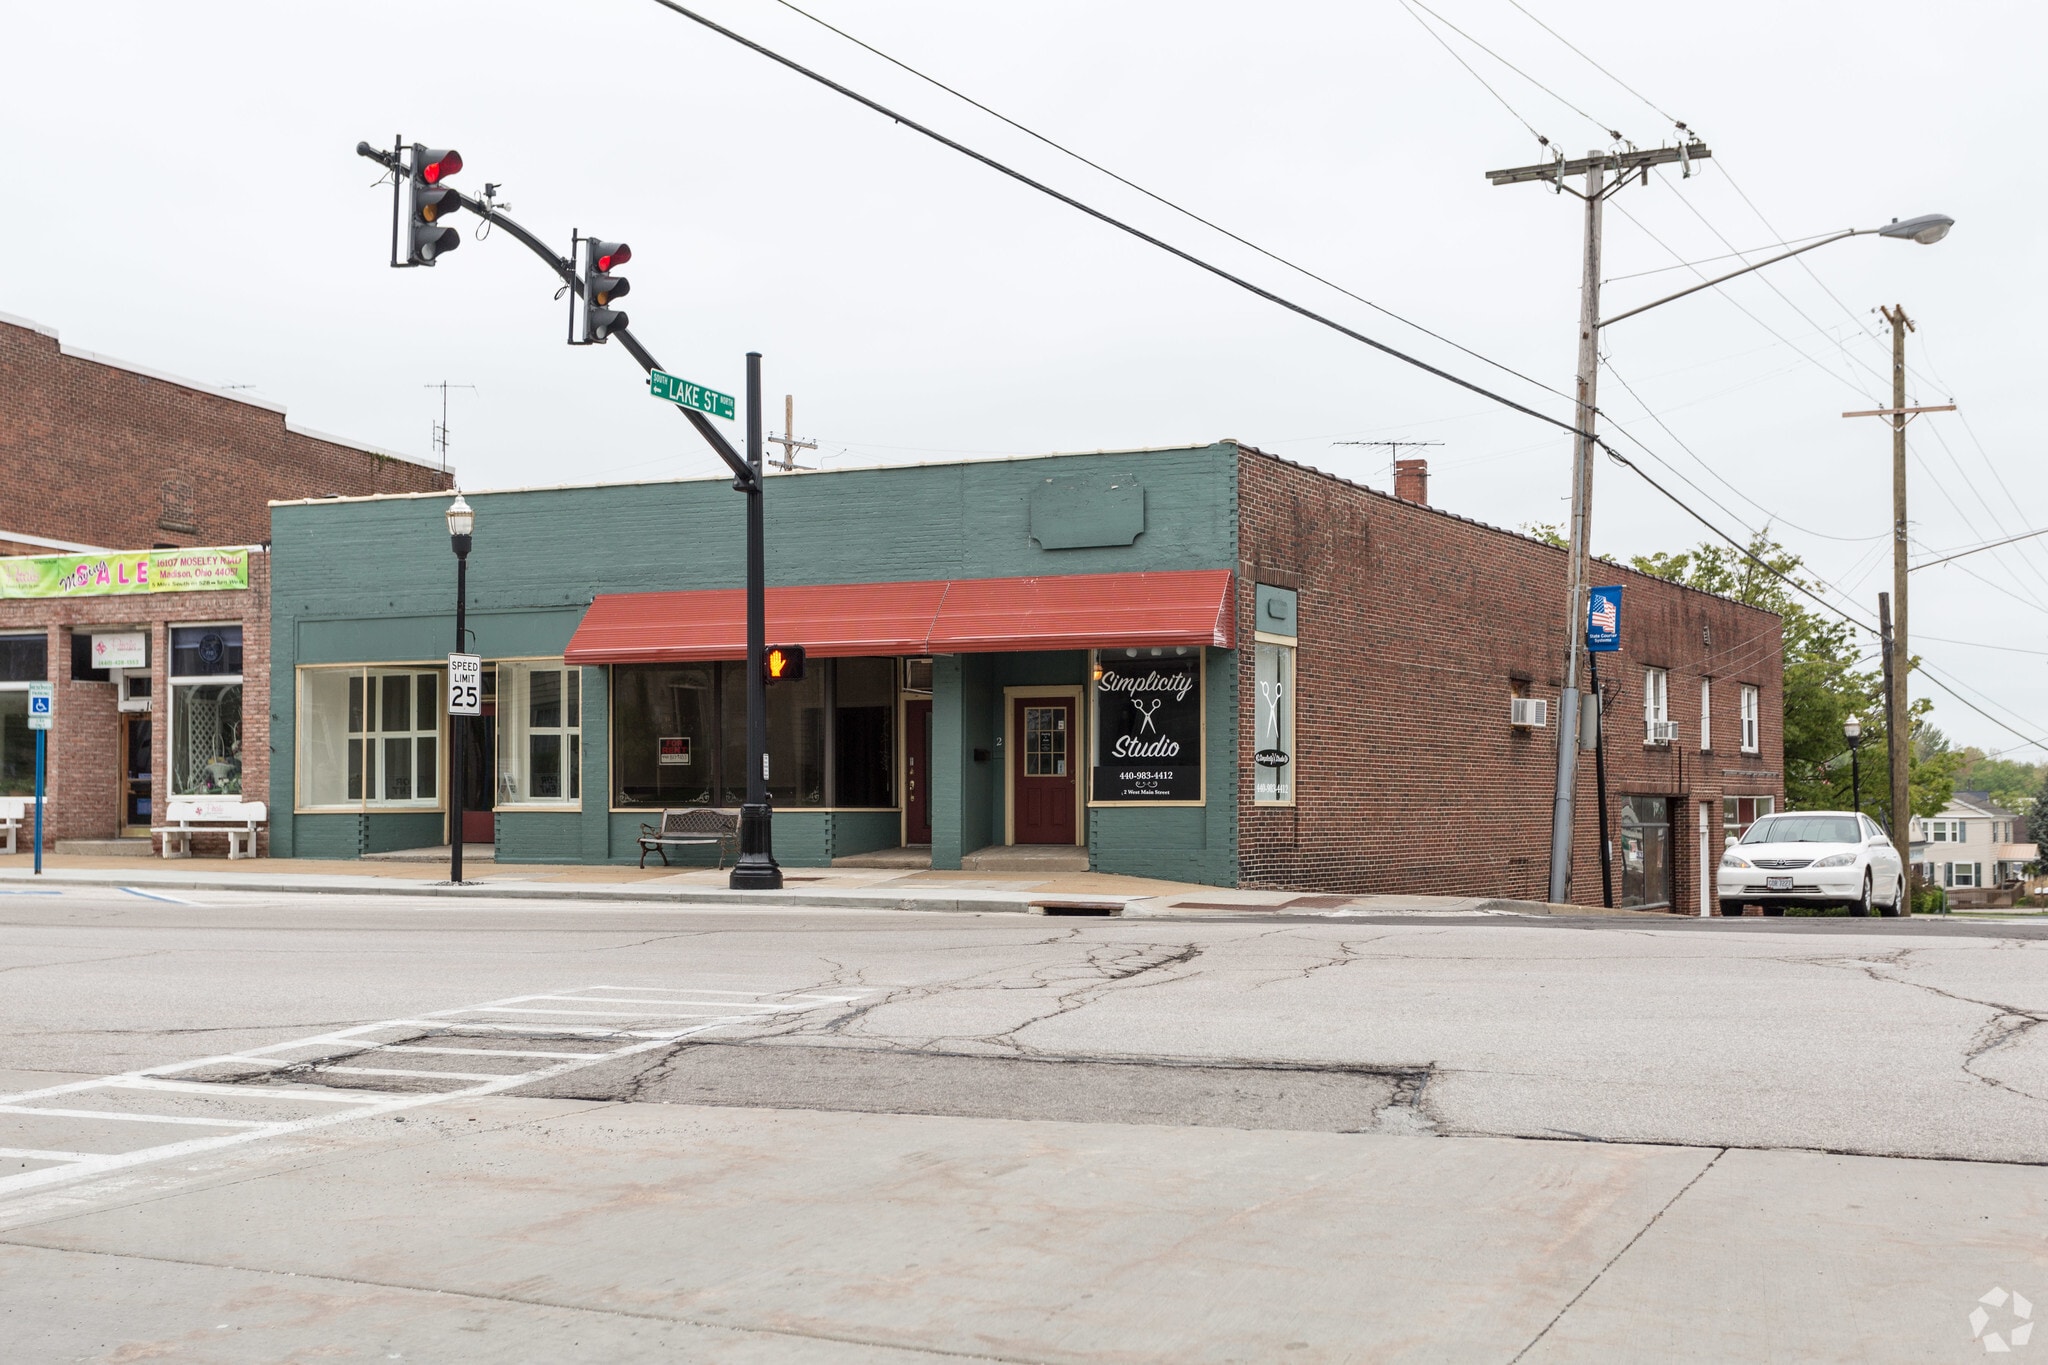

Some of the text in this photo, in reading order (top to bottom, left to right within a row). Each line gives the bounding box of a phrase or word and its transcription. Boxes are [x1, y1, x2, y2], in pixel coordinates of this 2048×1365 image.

[653, 373, 668, 385] SOUTH
[669, 378, 718, 413] LAKE ST
[720, 395, 734, 407] NORTH
[156, 558, 178, 567] 16107
[180, 556, 218, 566] MOSELEY
[60, 559, 107, 592] Moving
[76, 562, 148, 586] SALE
[159, 570, 193, 579] Madison,
[194, 568, 213, 577] Ohio
[452, 661, 478, 671] SPEED
[454, 674, 475, 683] LIMIT
[1098, 670, 1193, 702] Simplicity
[452, 686, 477, 708] 25
[996, 737, 1003, 746] 2
[1111, 734, 1180, 758] Studio
[661, 746, 687, 754] RENT
[1119, 771, 1173, 780] 440-983-4412
